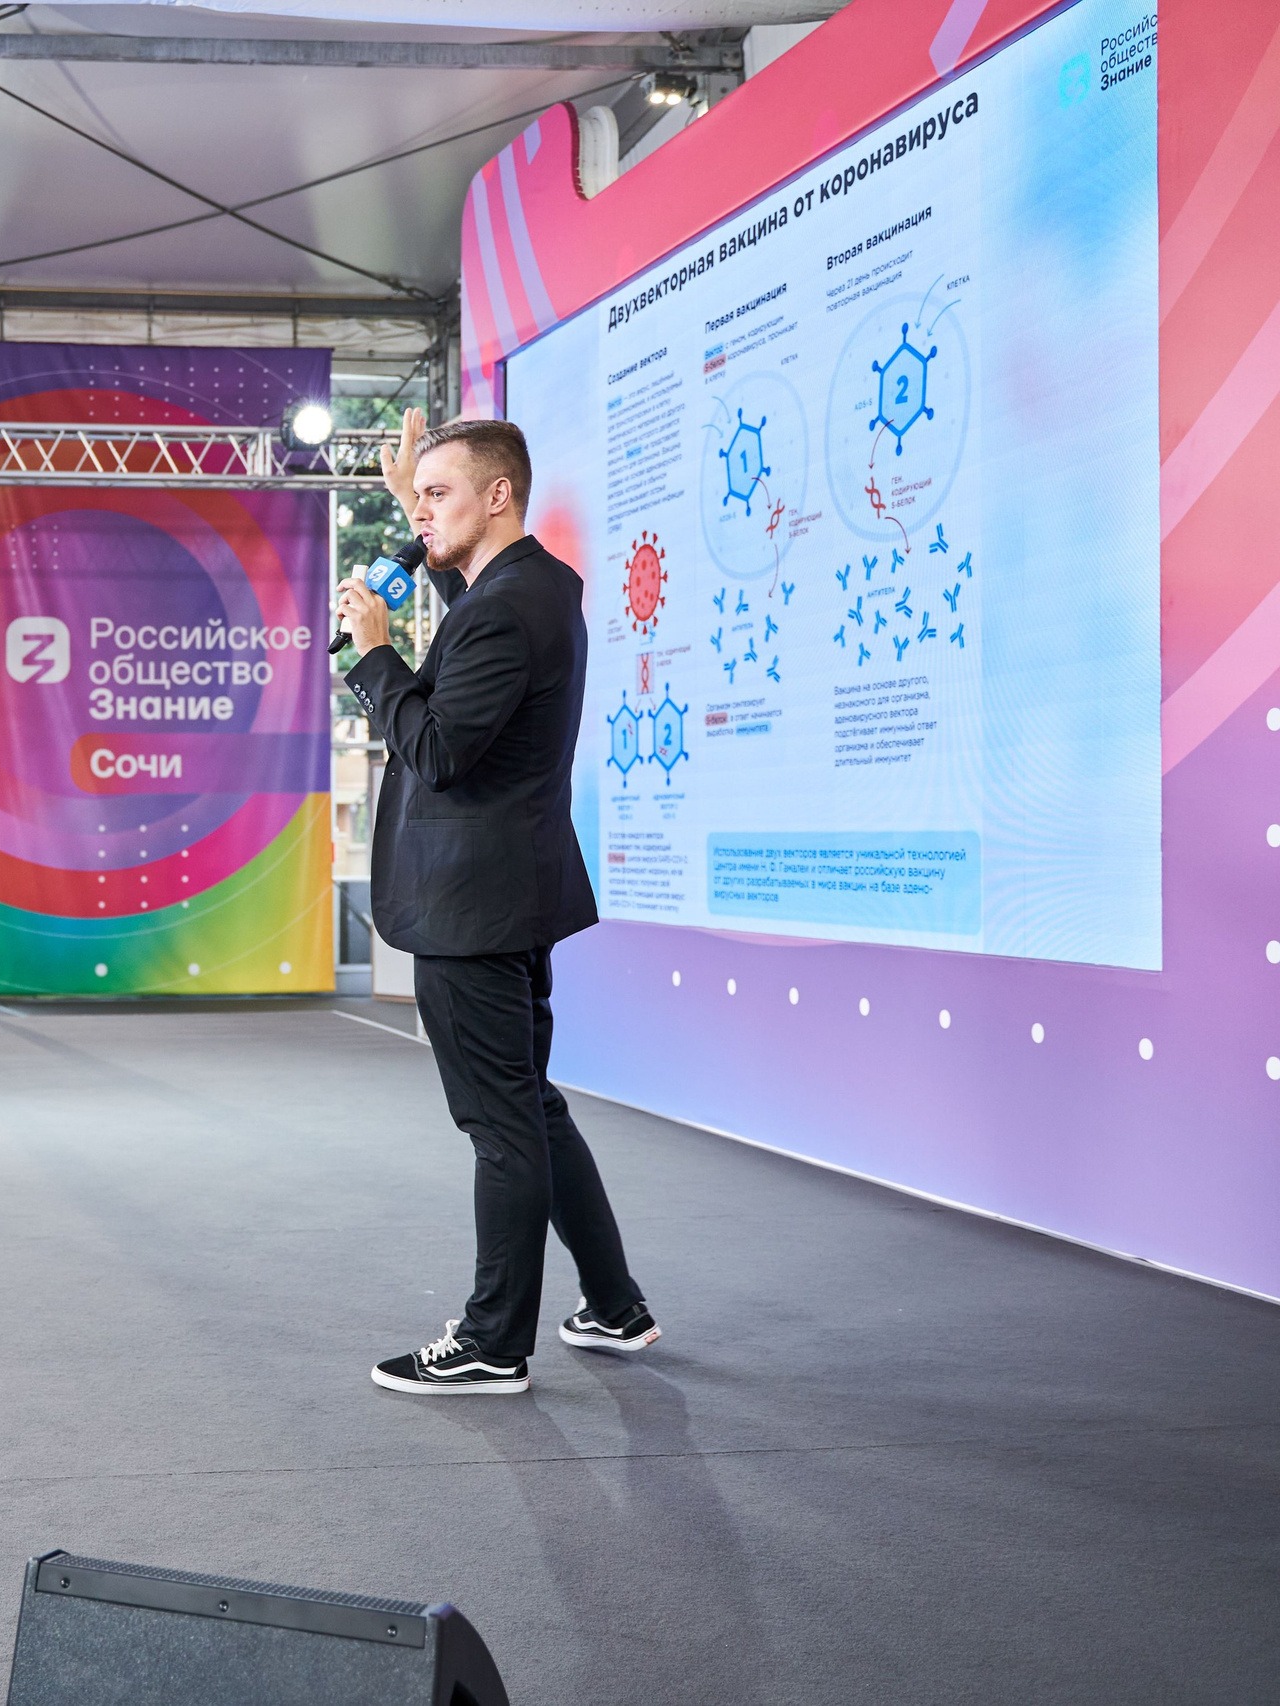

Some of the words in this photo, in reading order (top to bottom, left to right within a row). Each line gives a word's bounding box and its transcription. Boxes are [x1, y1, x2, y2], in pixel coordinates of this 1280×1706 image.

[1100, 54, 1152, 91] Знание
[608, 250, 714, 333] Двухвекторная
[719, 206, 788, 262] вакцина
[793, 189, 814, 217] от
[820, 92, 978, 203] коронавируса
[827, 243, 863, 270] Вторая
[866, 206, 932, 250] вакцинация
[871, 250, 913, 277] происходит
[862, 271, 902, 297] вакцинация
[946, 275, 970, 290] КЛЕТКА
[705, 310, 734, 334] Первая
[736, 283, 787, 318] вакцинация
[894, 375, 909, 404] 2
[740, 450, 748, 473] 1
[89, 617, 312, 650] Российское
[88, 653, 274, 690] общество
[88, 688, 234, 720] Знание
[890, 708, 918, 718] вектора
[622, 729, 627, 749] 1
[664, 723, 672, 746] 2
[90, 749, 182, 779] Сочи
[854, 848, 905, 861] уникальной
[907, 848, 966, 861] технологией
[854, 864, 906, 878] российскую
[908, 867, 946, 880] вакцину
[881, 880, 900, 893] базе
